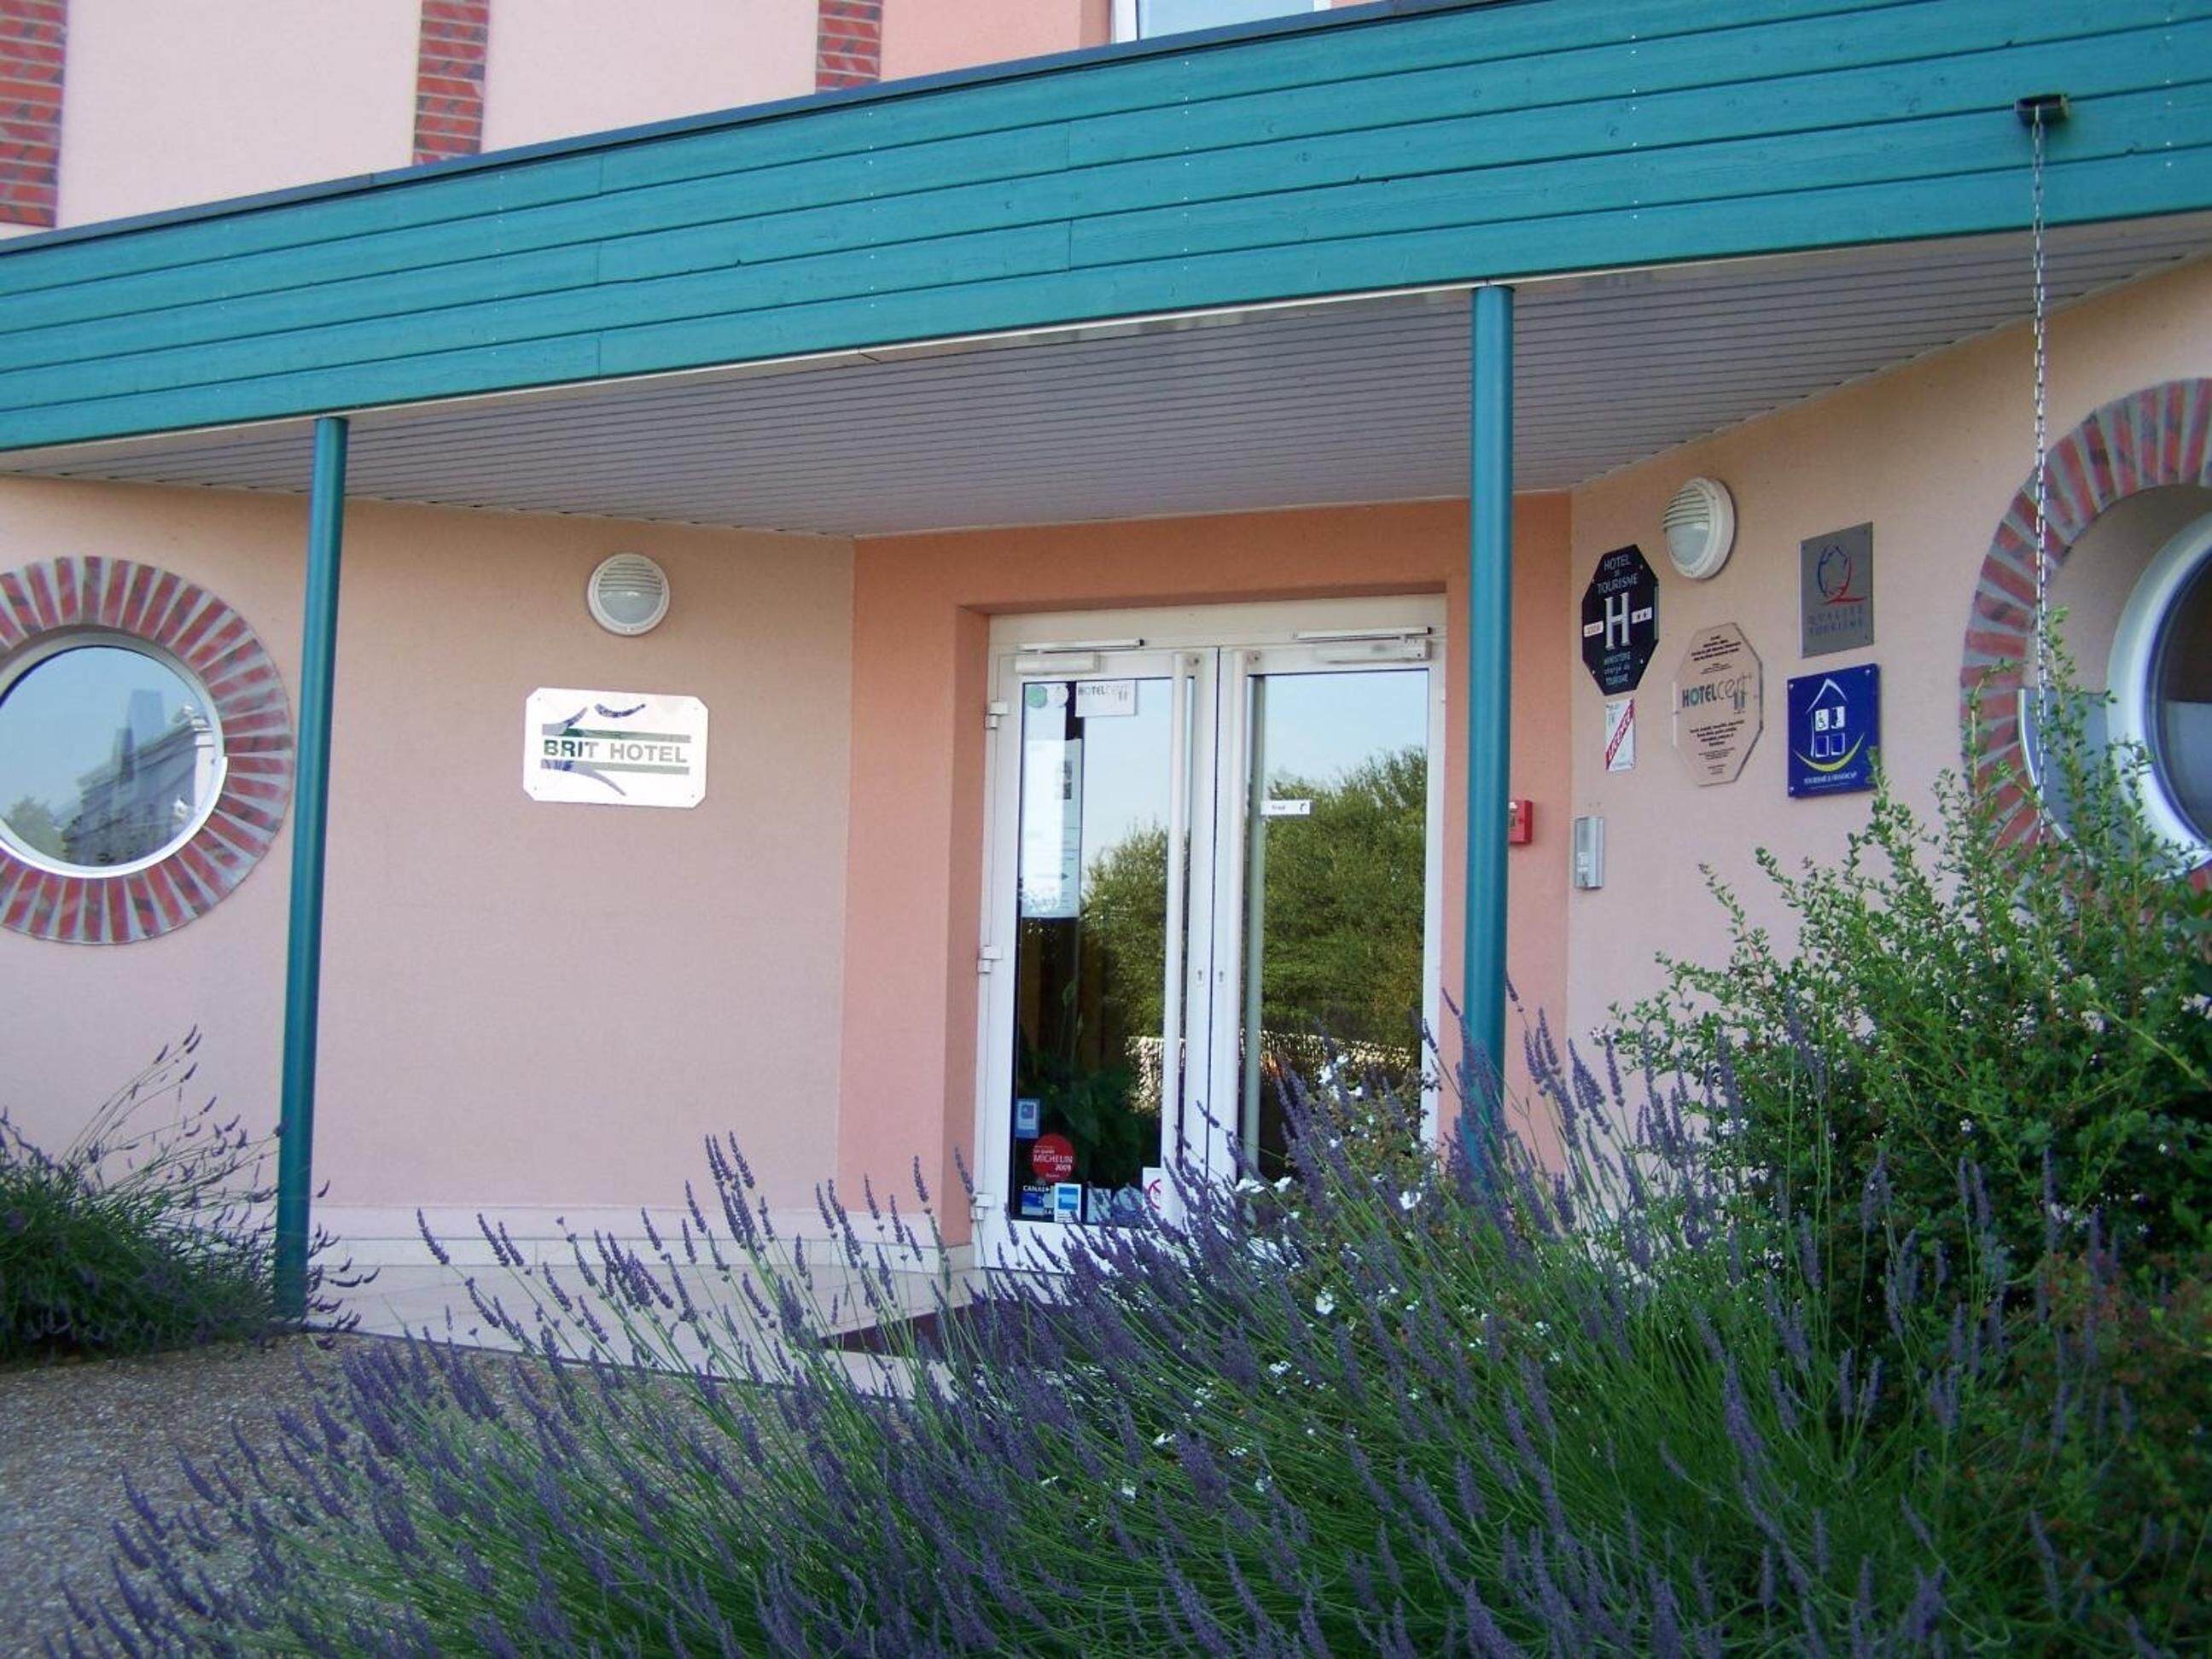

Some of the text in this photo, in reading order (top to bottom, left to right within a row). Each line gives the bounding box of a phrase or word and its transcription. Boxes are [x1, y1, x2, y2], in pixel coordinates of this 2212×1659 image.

[1604, 554, 1632, 571] HOTEL
[1597, 573, 1639, 595] TOURISME
[1604, 592, 1631, 650] H
[542, 739, 688, 764] BRIT HOTEL
[1033, 1154, 1074, 1163] MICHELIN
